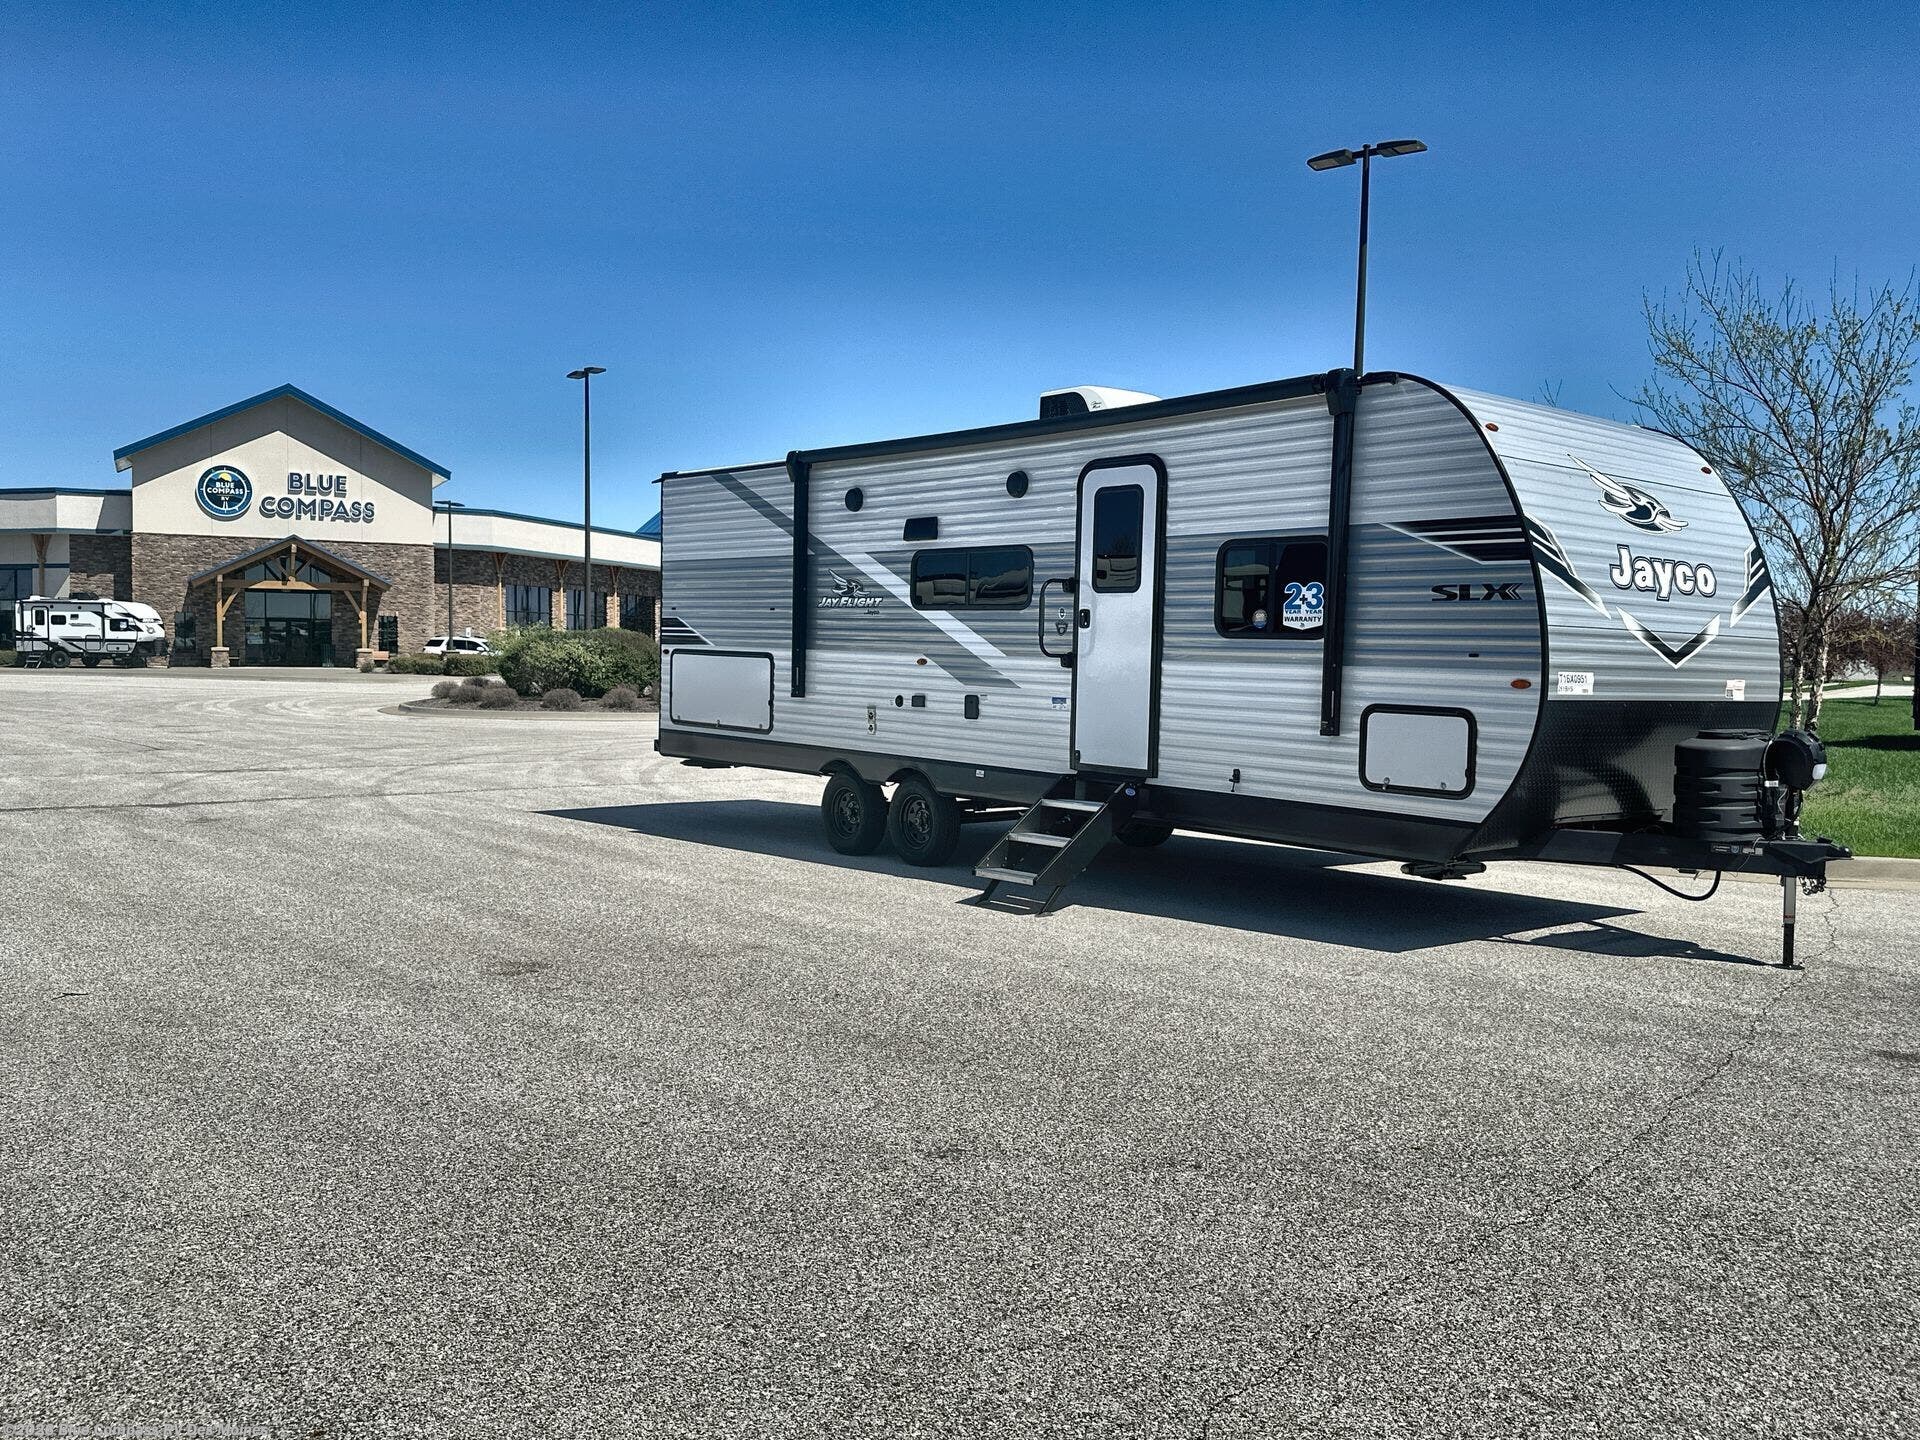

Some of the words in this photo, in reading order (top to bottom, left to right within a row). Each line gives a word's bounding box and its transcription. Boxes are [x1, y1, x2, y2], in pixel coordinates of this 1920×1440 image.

[206, 487, 244, 495] COMPASS
[288, 473, 347, 497] BLUE
[259, 496, 375, 523] COMPASS
[1609, 543, 1718, 602] Jayco
[818, 596, 839, 608] JAY
[839, 596, 883, 608] FLIGHT
[1431, 583, 1523, 601] SLX
